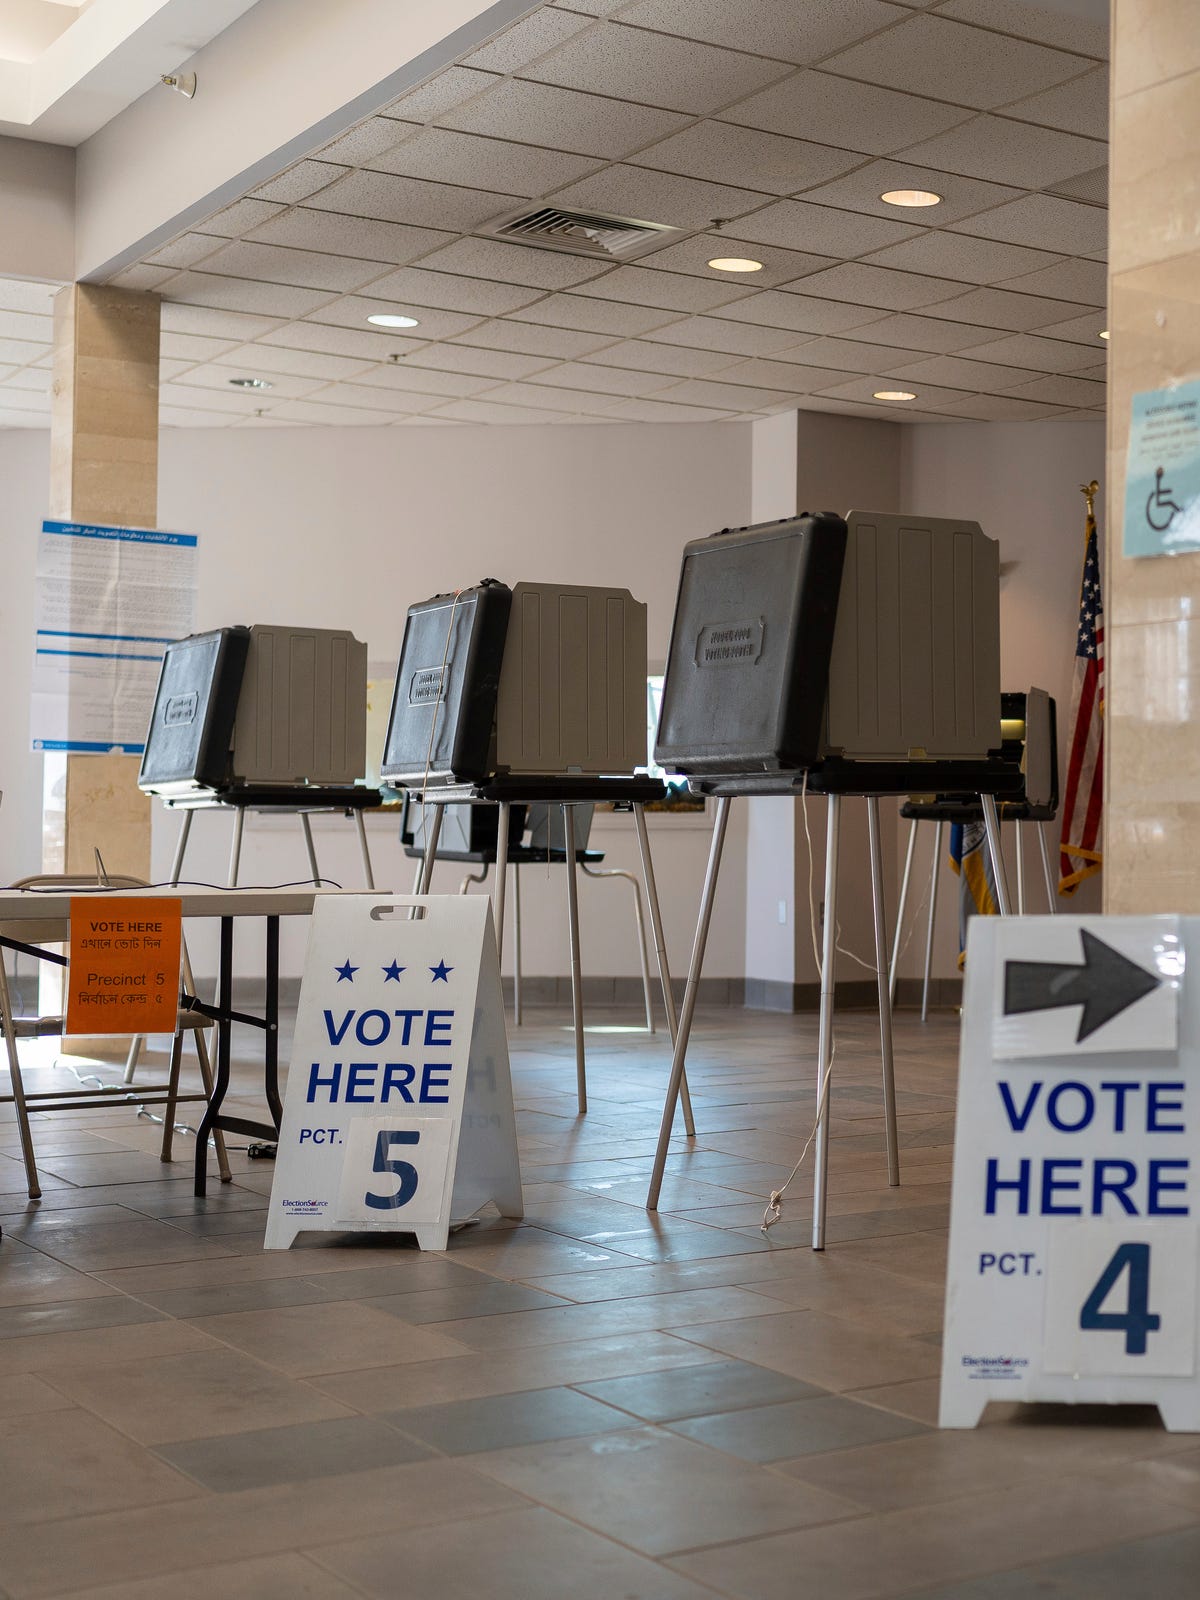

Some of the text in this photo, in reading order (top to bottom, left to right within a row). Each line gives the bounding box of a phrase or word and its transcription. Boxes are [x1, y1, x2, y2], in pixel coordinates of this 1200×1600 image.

[80, 936, 162, 950] এখানে ভোট দিন
[90, 922, 163, 932] VOTE HERE
[87, 973, 165, 986] Precinct 5
[323, 1009, 455, 1047] VOTE
[306, 1063, 453, 1103] HERE
[997, 1080, 1187, 1133] VOTE
[299, 1128, 421, 1211] PCT. 5
[983, 1158, 1191, 1217] HERE
[978, 1242, 1162, 1357] PCT. 4
